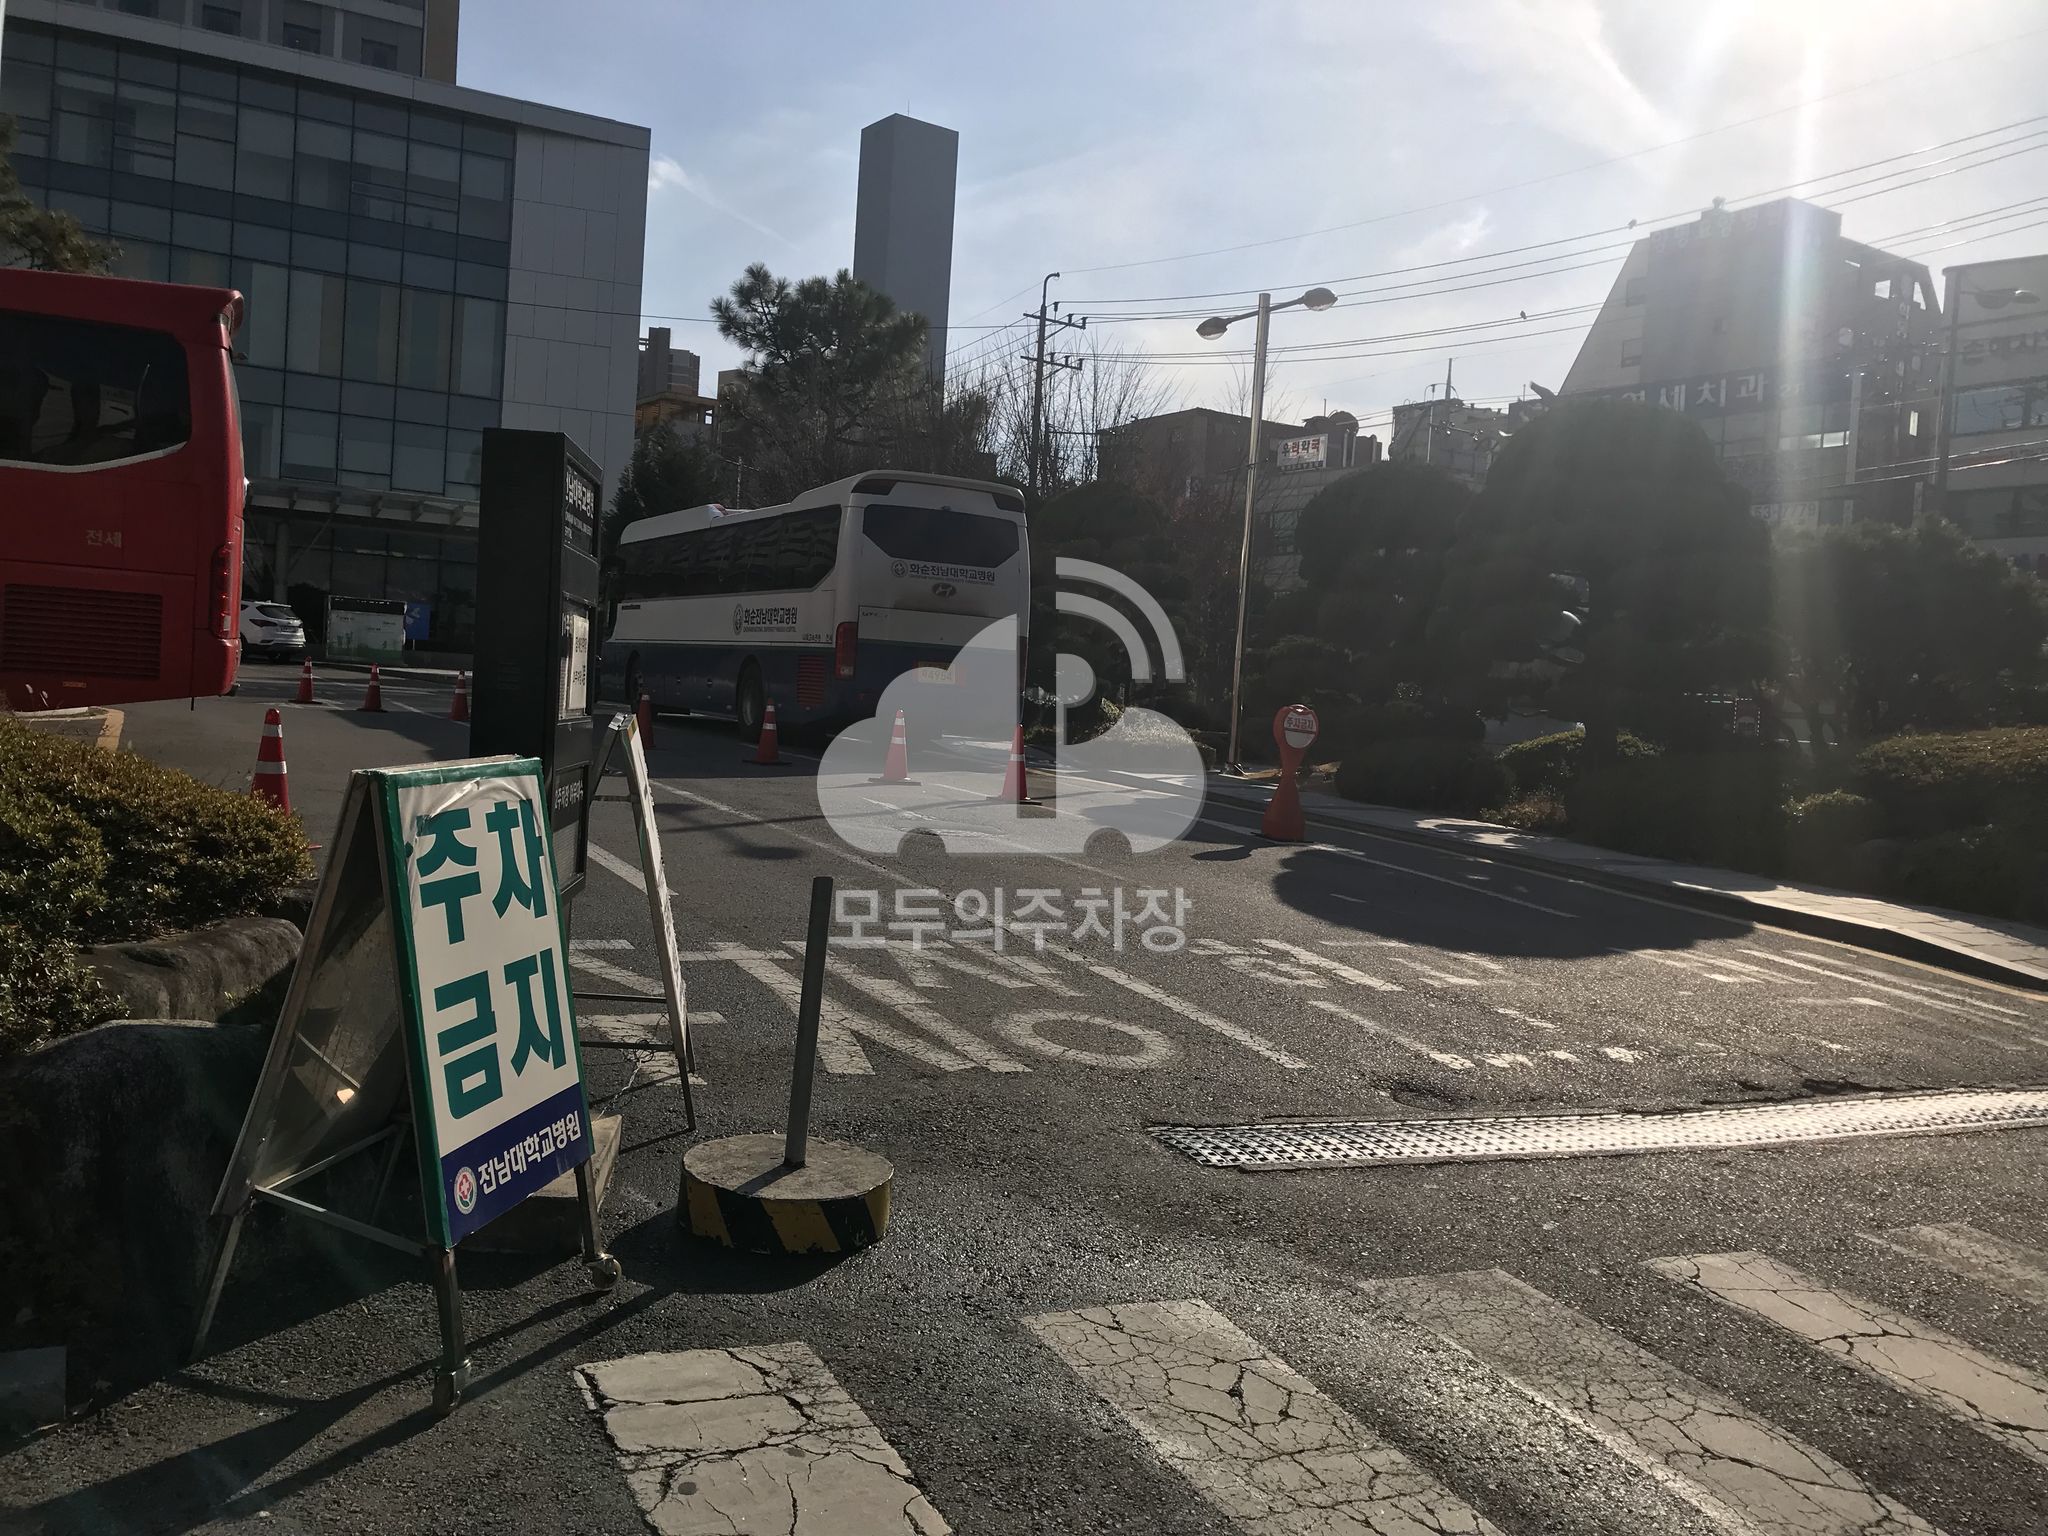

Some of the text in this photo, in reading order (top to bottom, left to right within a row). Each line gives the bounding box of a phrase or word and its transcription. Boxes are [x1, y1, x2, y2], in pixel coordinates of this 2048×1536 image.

[86, 529, 122, 549] 전세
[909, 563, 996, 582] 화순전남대학교병원
[743, 607, 798, 625] 화순전남대학교병원
[1286, 716, 1314, 730] 주차금지
[414, 798, 548, 945] 주차
[433, 948, 568, 1121] 금지
[477, 1110, 582, 1196] 전남대학교병원
